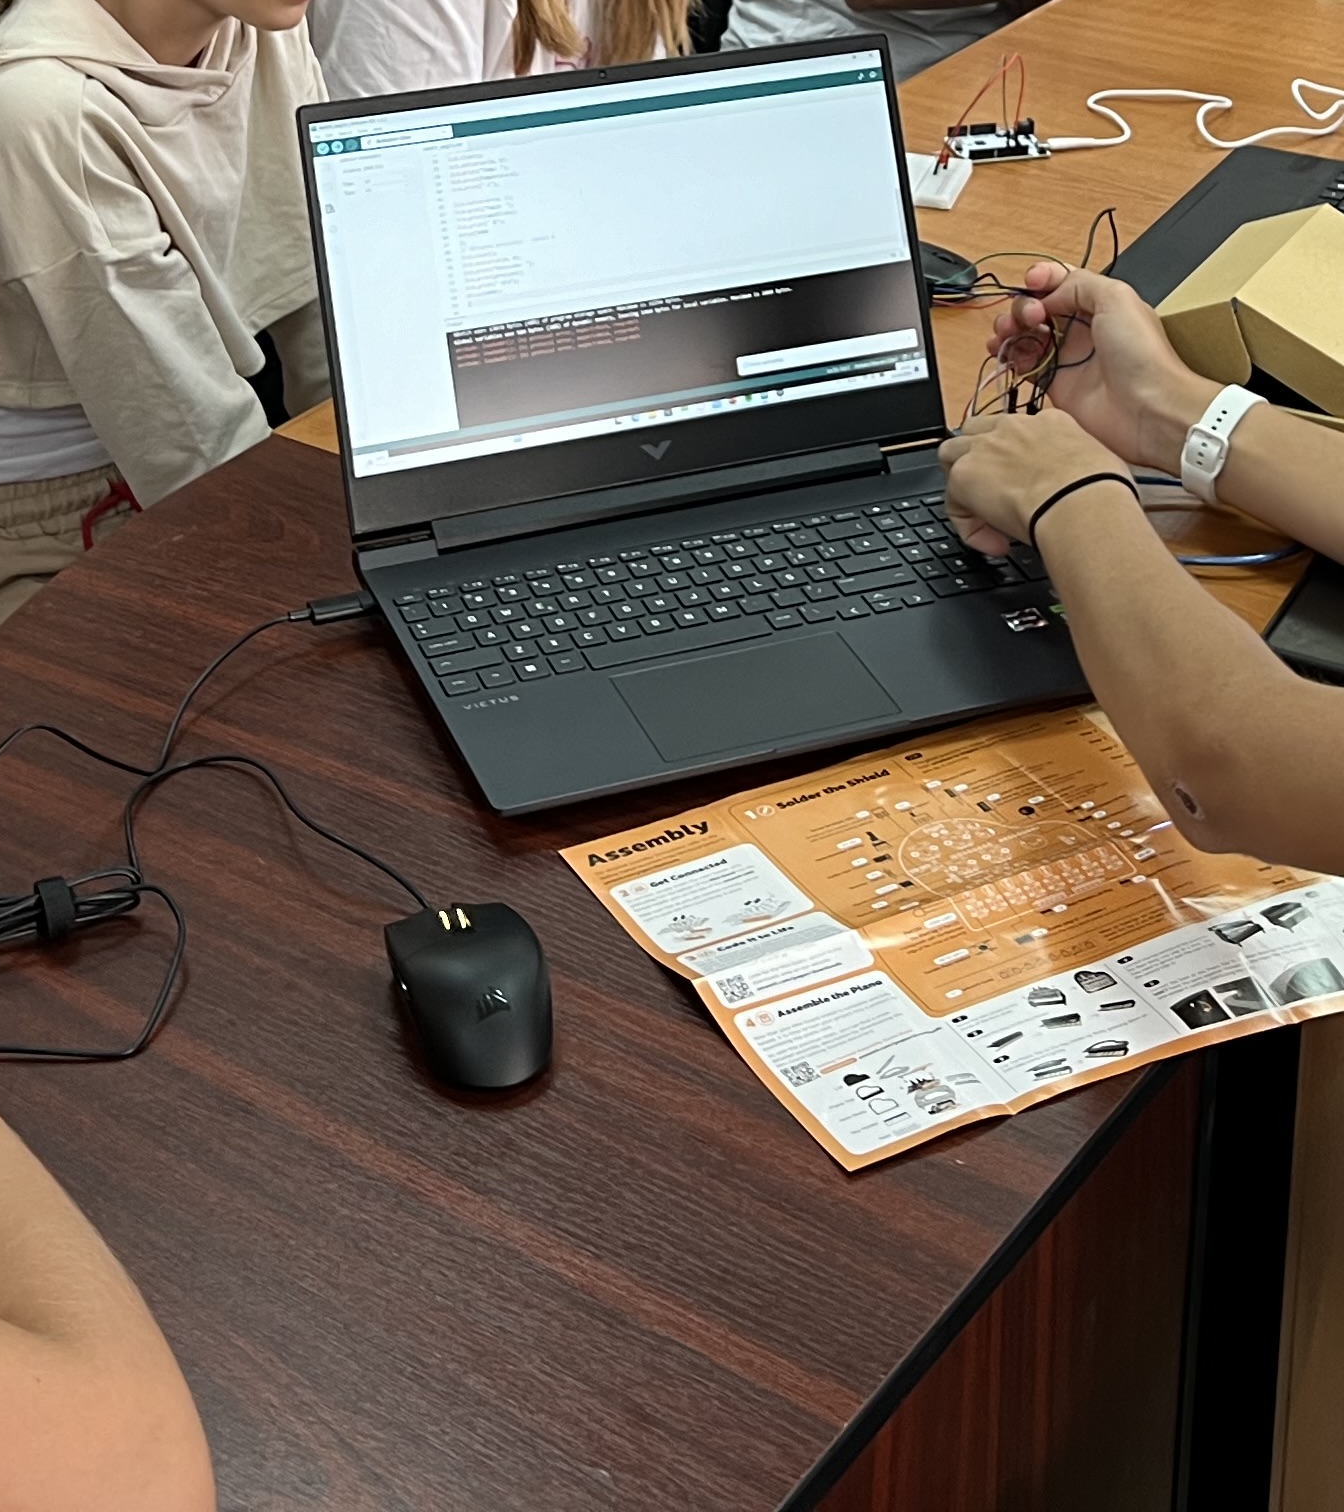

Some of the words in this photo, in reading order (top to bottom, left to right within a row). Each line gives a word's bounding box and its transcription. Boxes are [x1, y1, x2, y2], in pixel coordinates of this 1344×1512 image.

[463, 695, 520, 710] VICTUS
[775, 789, 822, 810] Solder
[822, 783, 847, 795] the
[846, 769, 891, 791] Shield
[587, 820, 710, 867] Assembly
[649, 878, 669, 889] Get
[670, 858, 728, 882] Connected
[777, 996, 831, 1018] Assemble
[830, 989, 850, 1001] the
[850, 980, 883, 995] Piano
